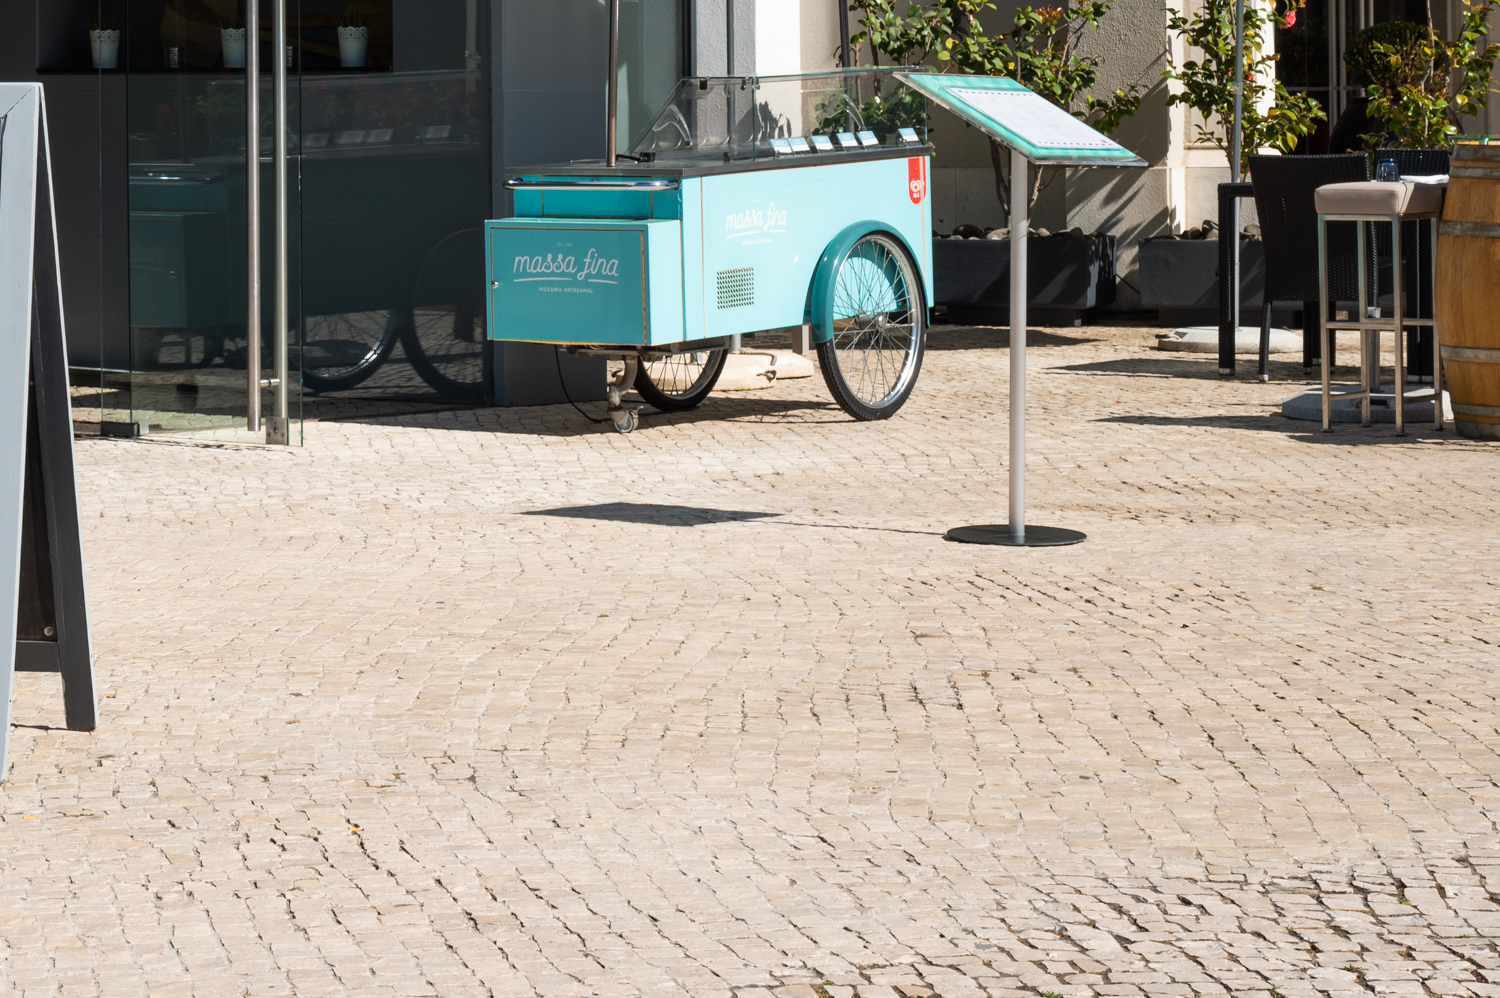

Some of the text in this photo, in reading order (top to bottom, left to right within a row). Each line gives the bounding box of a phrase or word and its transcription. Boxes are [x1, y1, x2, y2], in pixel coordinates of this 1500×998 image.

[725, 202, 788, 233] massa fina
[513, 248, 619, 281] massa fina
